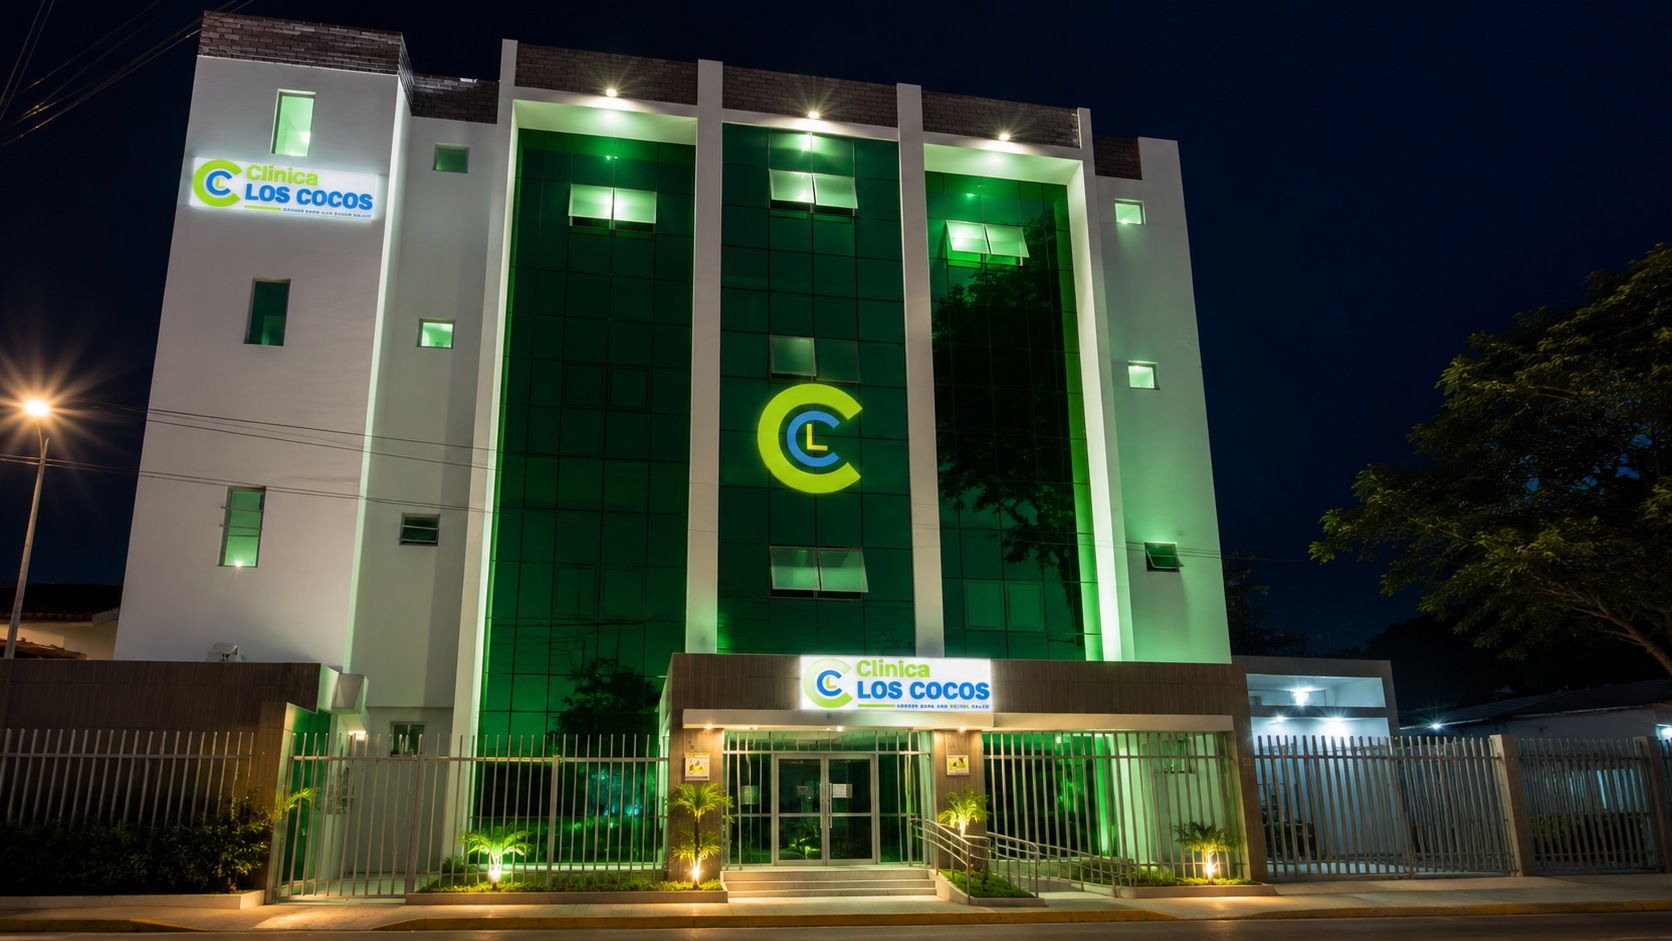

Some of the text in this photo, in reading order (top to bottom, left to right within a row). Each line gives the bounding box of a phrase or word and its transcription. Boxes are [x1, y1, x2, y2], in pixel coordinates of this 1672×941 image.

[245, 183, 374, 211] LOS COCOS
[857, 680, 991, 701] LOS COCOS
